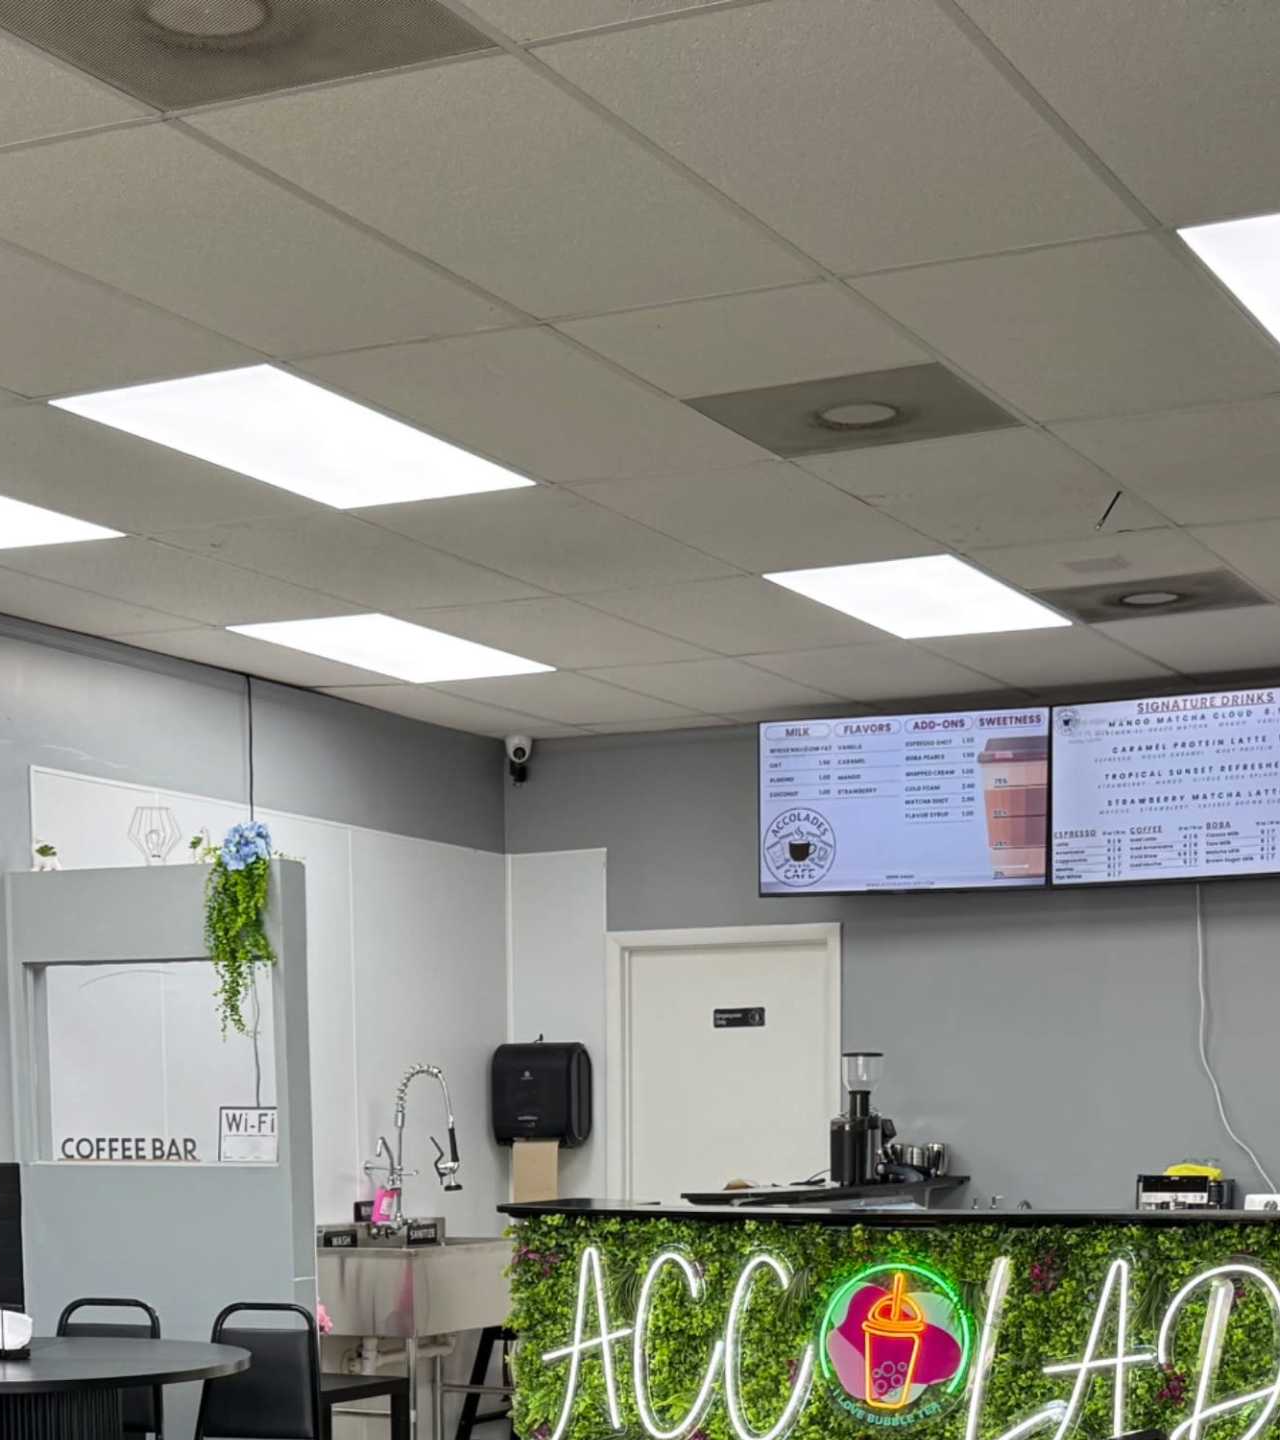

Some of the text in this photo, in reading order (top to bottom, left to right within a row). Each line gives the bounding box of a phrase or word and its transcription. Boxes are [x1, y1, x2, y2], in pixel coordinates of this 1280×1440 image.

[1136, 691, 1275, 714] SIGNATURE DRINKS
[913, 718, 966, 731] ADD-ONS
[979, 714, 1042, 727] SWEETNESS
[1108, 718, 1151, 728] MANGO
[1156, 714, 1207, 724] MATCHA
[1213, 709, 1253, 720] CLOUD
[785, 727, 810, 738] MILK
[843, 722, 892, 735] FLAVORS
[1111, 743, 1167, 754] CARAMEL
[1173, 738, 1224, 749] PROTEIN
[1230, 735, 1267, 745] LATTE
[1104, 771, 1163, 781] TROPICAL
[1168, 765, 1214, 776] SUNSET
[1107, 794, 1186, 807] STRAWBERRY
[1191, 791, 1242, 801] MATCHA
[770, 811, 830, 838] ACCOLADES
[1129, 825, 1163, 836] COFFEE
[1205, 821, 1232, 831] BOBA
[1053, 829, 1097, 840] ESPRESSO
[224, 1111, 276, 1134] Wi-Fi
[61, 1137, 198, 1161] COFFEE BAR
[838, 1396, 866, 1420] LOVE
[867, 1413, 915, 1426] BUBBLE
[919, 1402, 941, 1419] TEA
